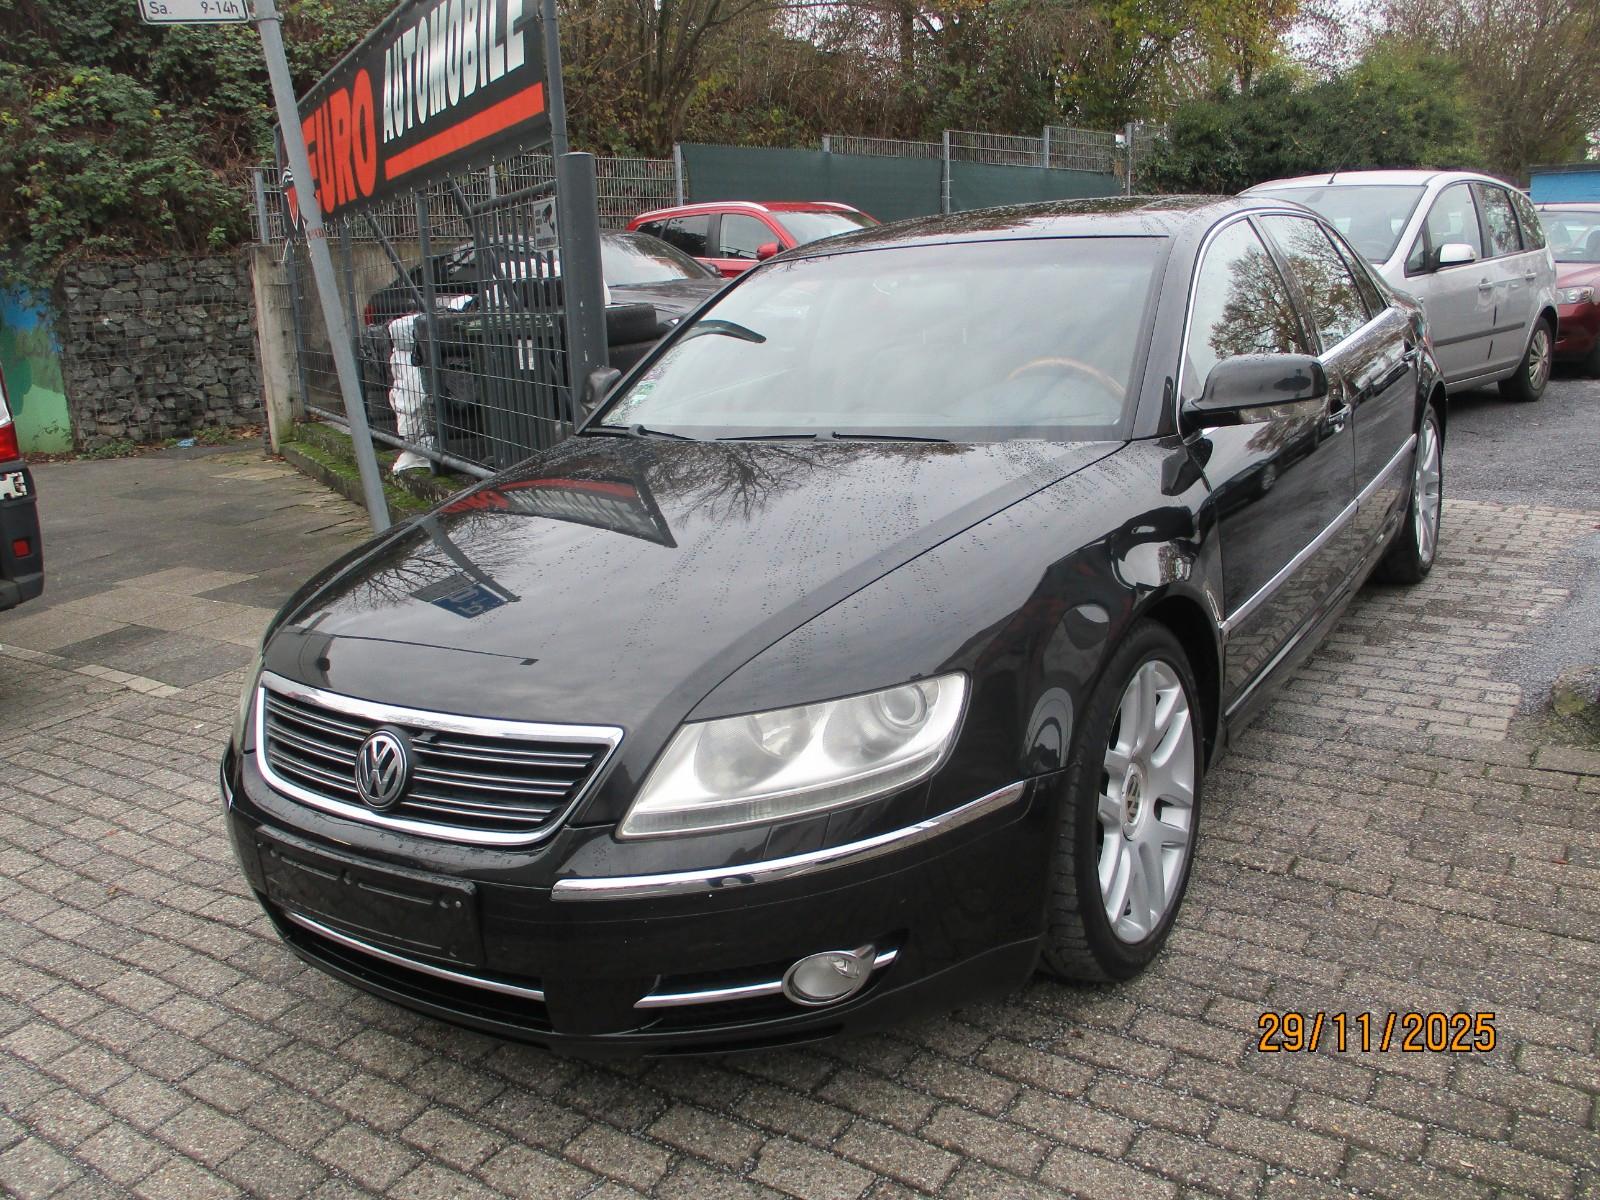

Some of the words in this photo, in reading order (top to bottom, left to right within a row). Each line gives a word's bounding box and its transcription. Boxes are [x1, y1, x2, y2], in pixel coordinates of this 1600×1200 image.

[149, 1, 172, 15] Sa.
[200, 1, 239, 14] 9-14h
[301, 68, 377, 214] EURO
[383, 0, 525, 144] AUTOMOBILE
[357, 732, 406, 807] VW
